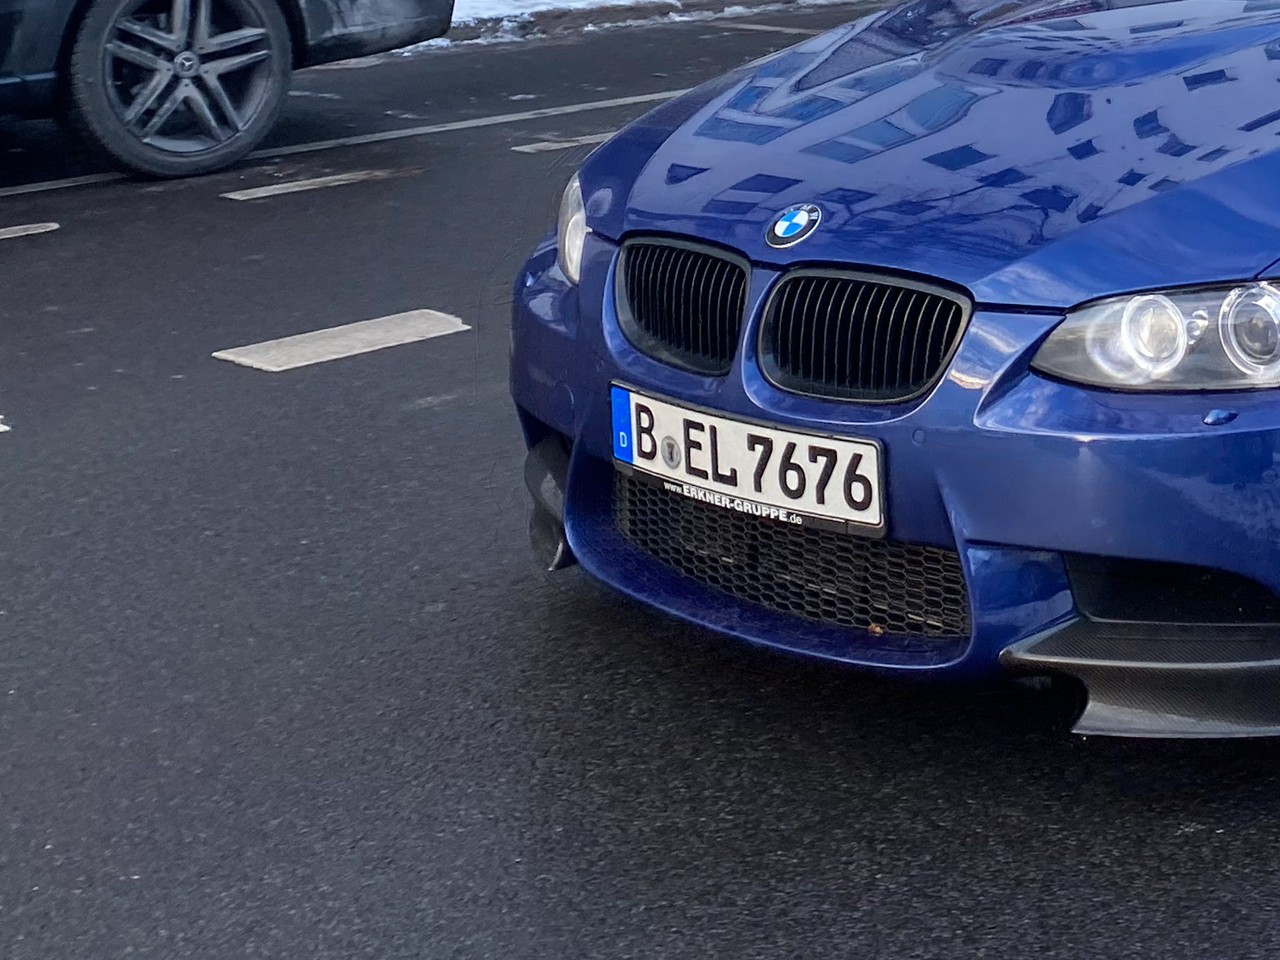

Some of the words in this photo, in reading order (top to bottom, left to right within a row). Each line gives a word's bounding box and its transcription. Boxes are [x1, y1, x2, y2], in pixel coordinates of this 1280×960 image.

[619, 431, 628, 448] D
[634, 401, 658, 461] B
[682, 418, 738, 488] EL
[747, 432, 874, 512] 7676
[663, 480, 803, 526] www.ERKNER-GRUPPE.de
